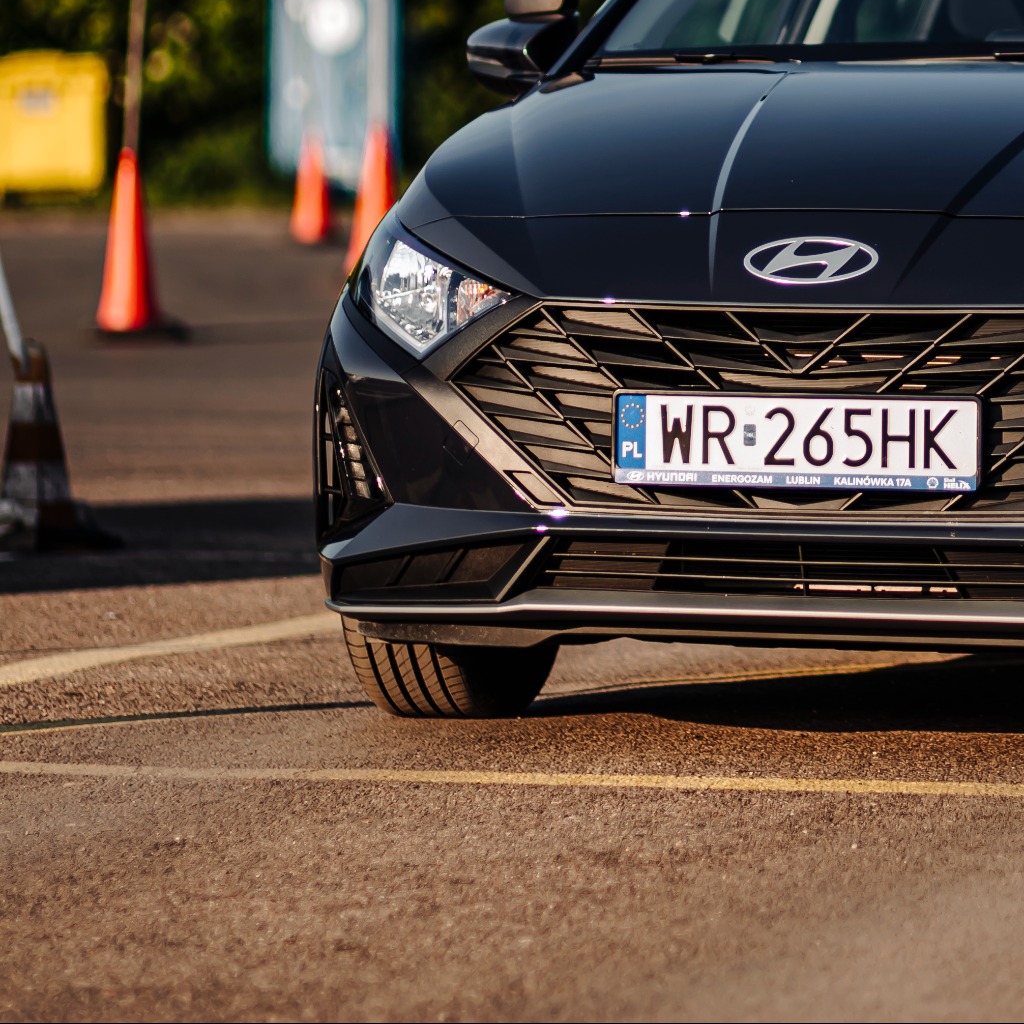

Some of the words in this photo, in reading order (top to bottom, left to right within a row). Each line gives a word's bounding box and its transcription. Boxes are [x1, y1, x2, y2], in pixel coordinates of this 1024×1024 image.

[660, 404, 735, 465] WR
[763, 407, 958, 470] 265HK
[621, 441, 643, 458] PL
[646, 472, 698, 483] HYUNDAI
[711, 474, 773, 484] ENERGOZAM
[785, 476, 821, 485] LUBLIN
[833, 475, 894, 488] KALINÓWKA
[895, 478, 912, 488] 17A
[943, 482, 971, 490] HELIX
